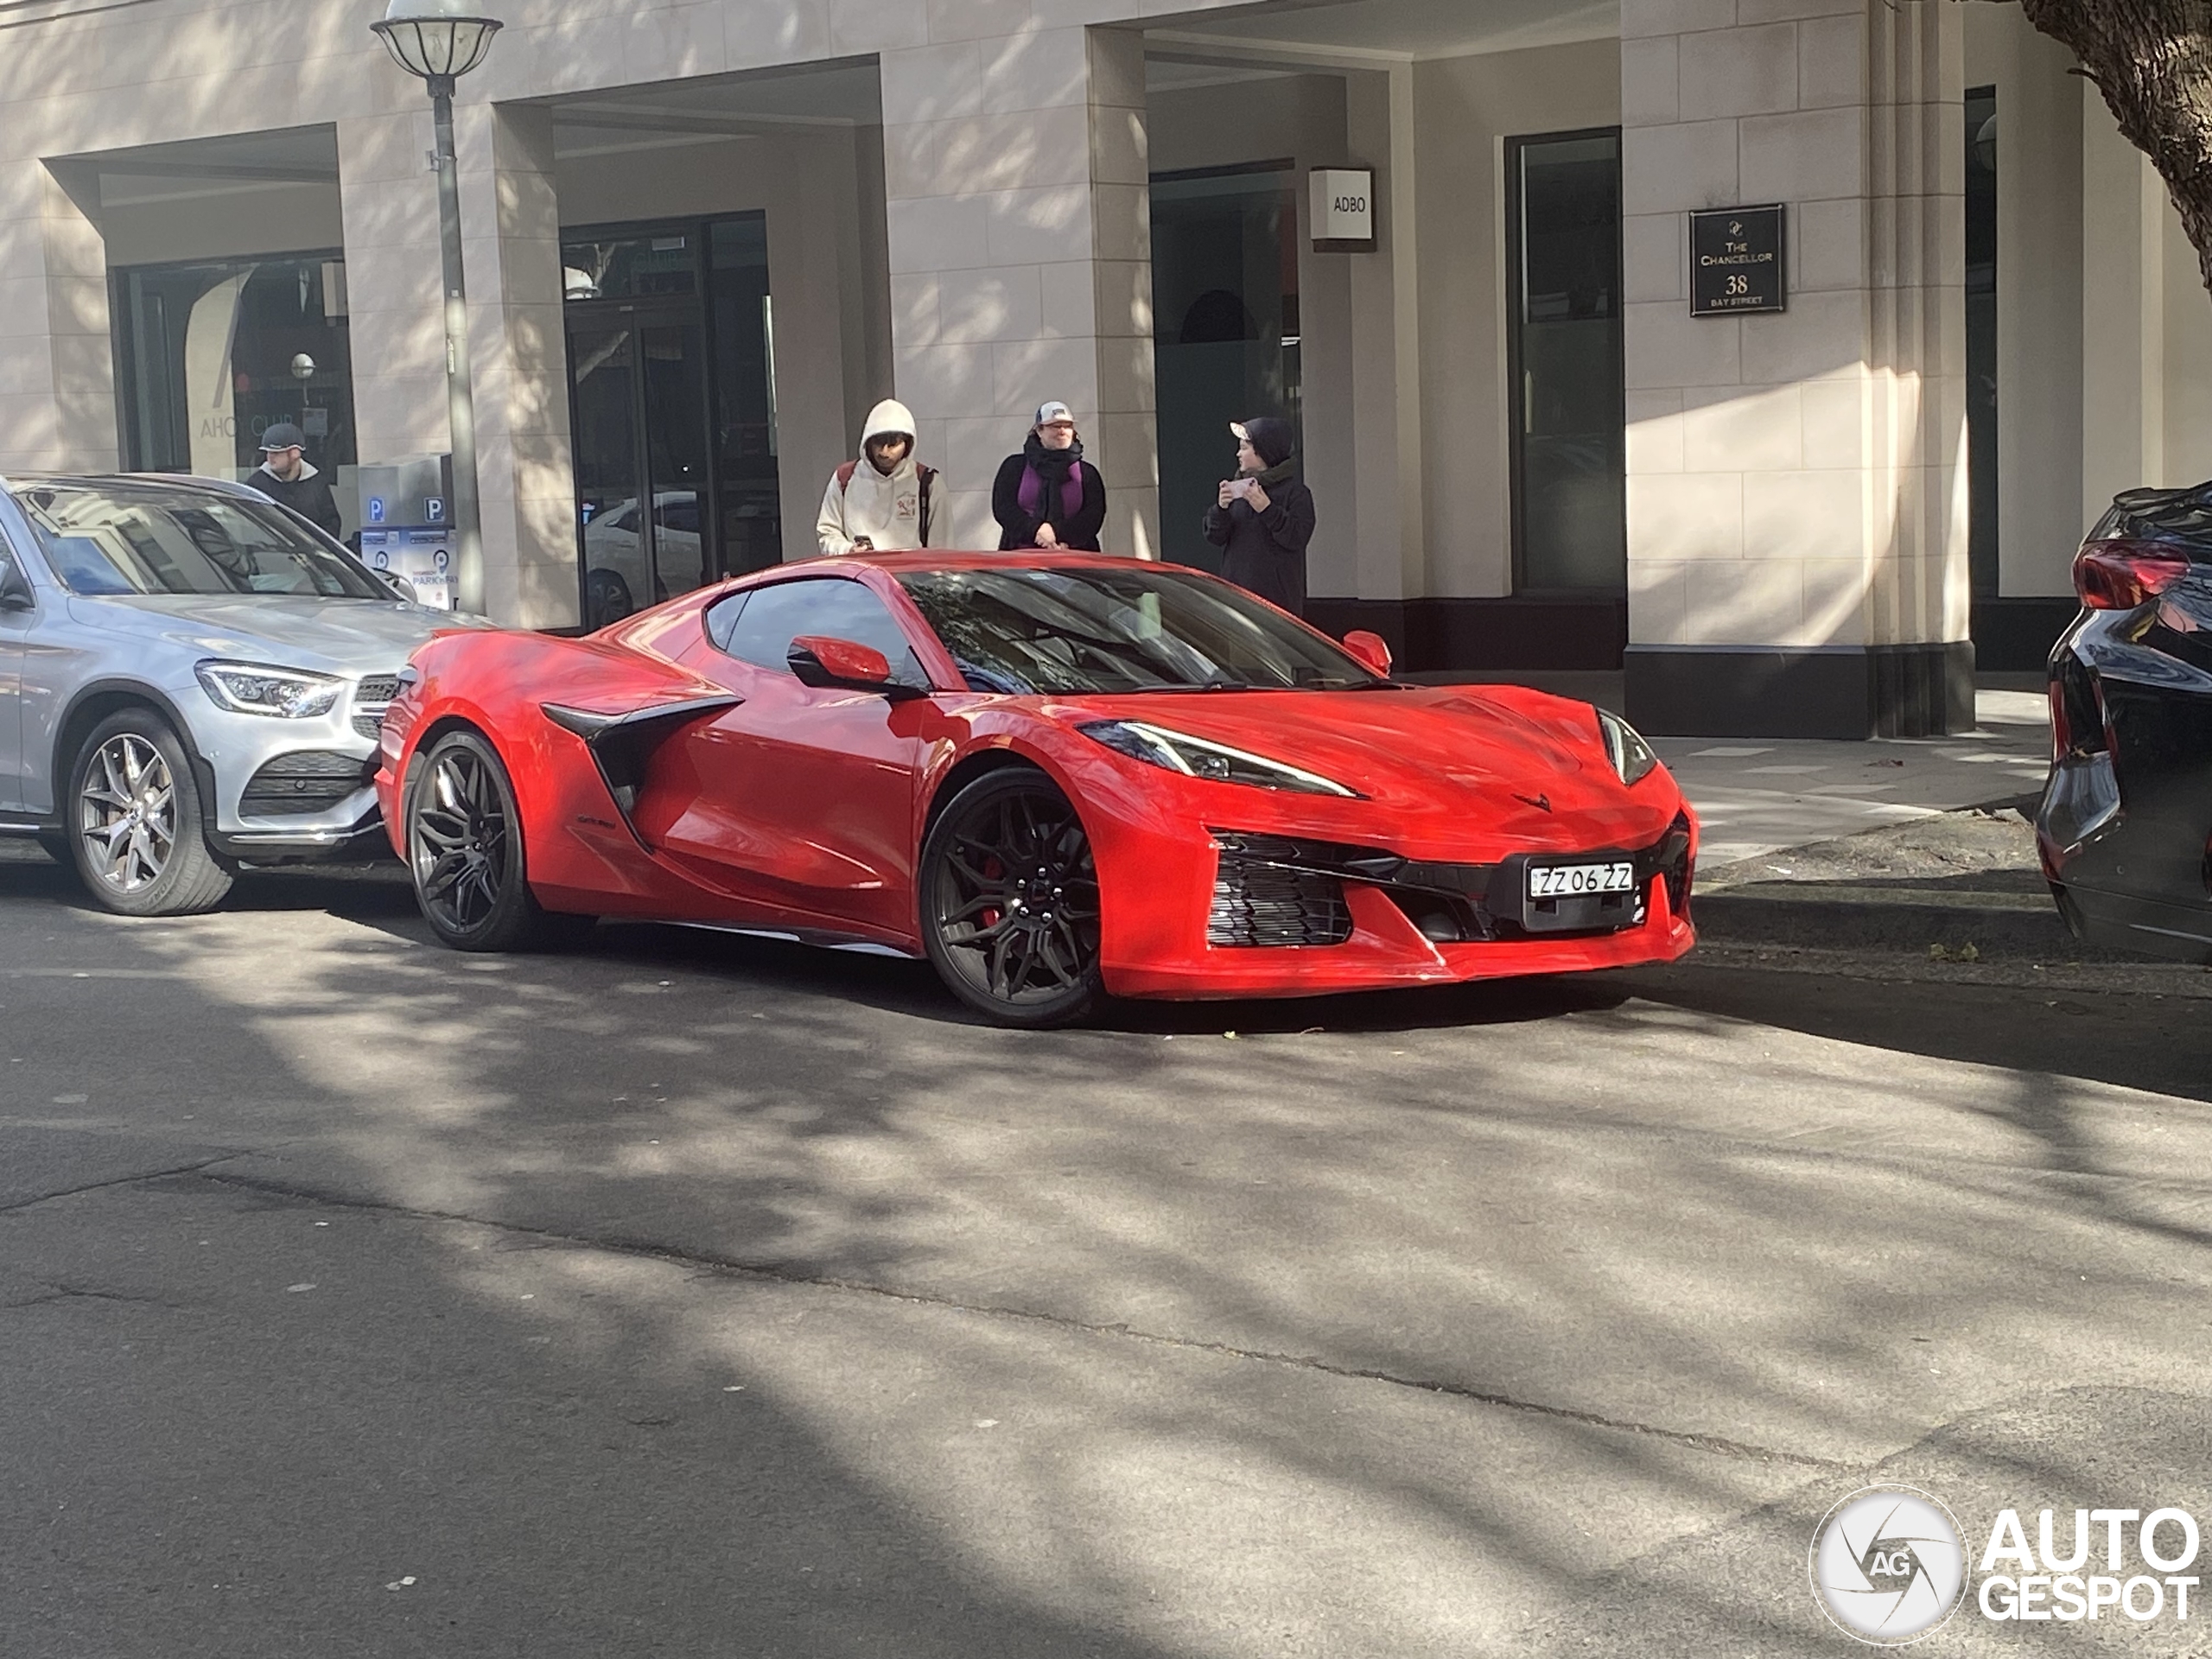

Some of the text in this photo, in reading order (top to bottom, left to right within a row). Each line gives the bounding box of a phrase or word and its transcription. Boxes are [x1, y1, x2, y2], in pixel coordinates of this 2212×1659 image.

[1334, 196, 1366, 213] ADBO
[1726, 242, 1747, 253] THE
[1700, 252, 1773, 266] CHANCELLOR
[1725, 275, 1748, 295] 38
[1711, 296, 1763, 307] BAY STREET
[371, 500, 381, 520] P
[429, 499, 442, 520] P
[1540, 871, 1566, 893] ZZ
[1572, 869, 1598, 891] 06
[1604, 867, 1630, 889] ZZ
